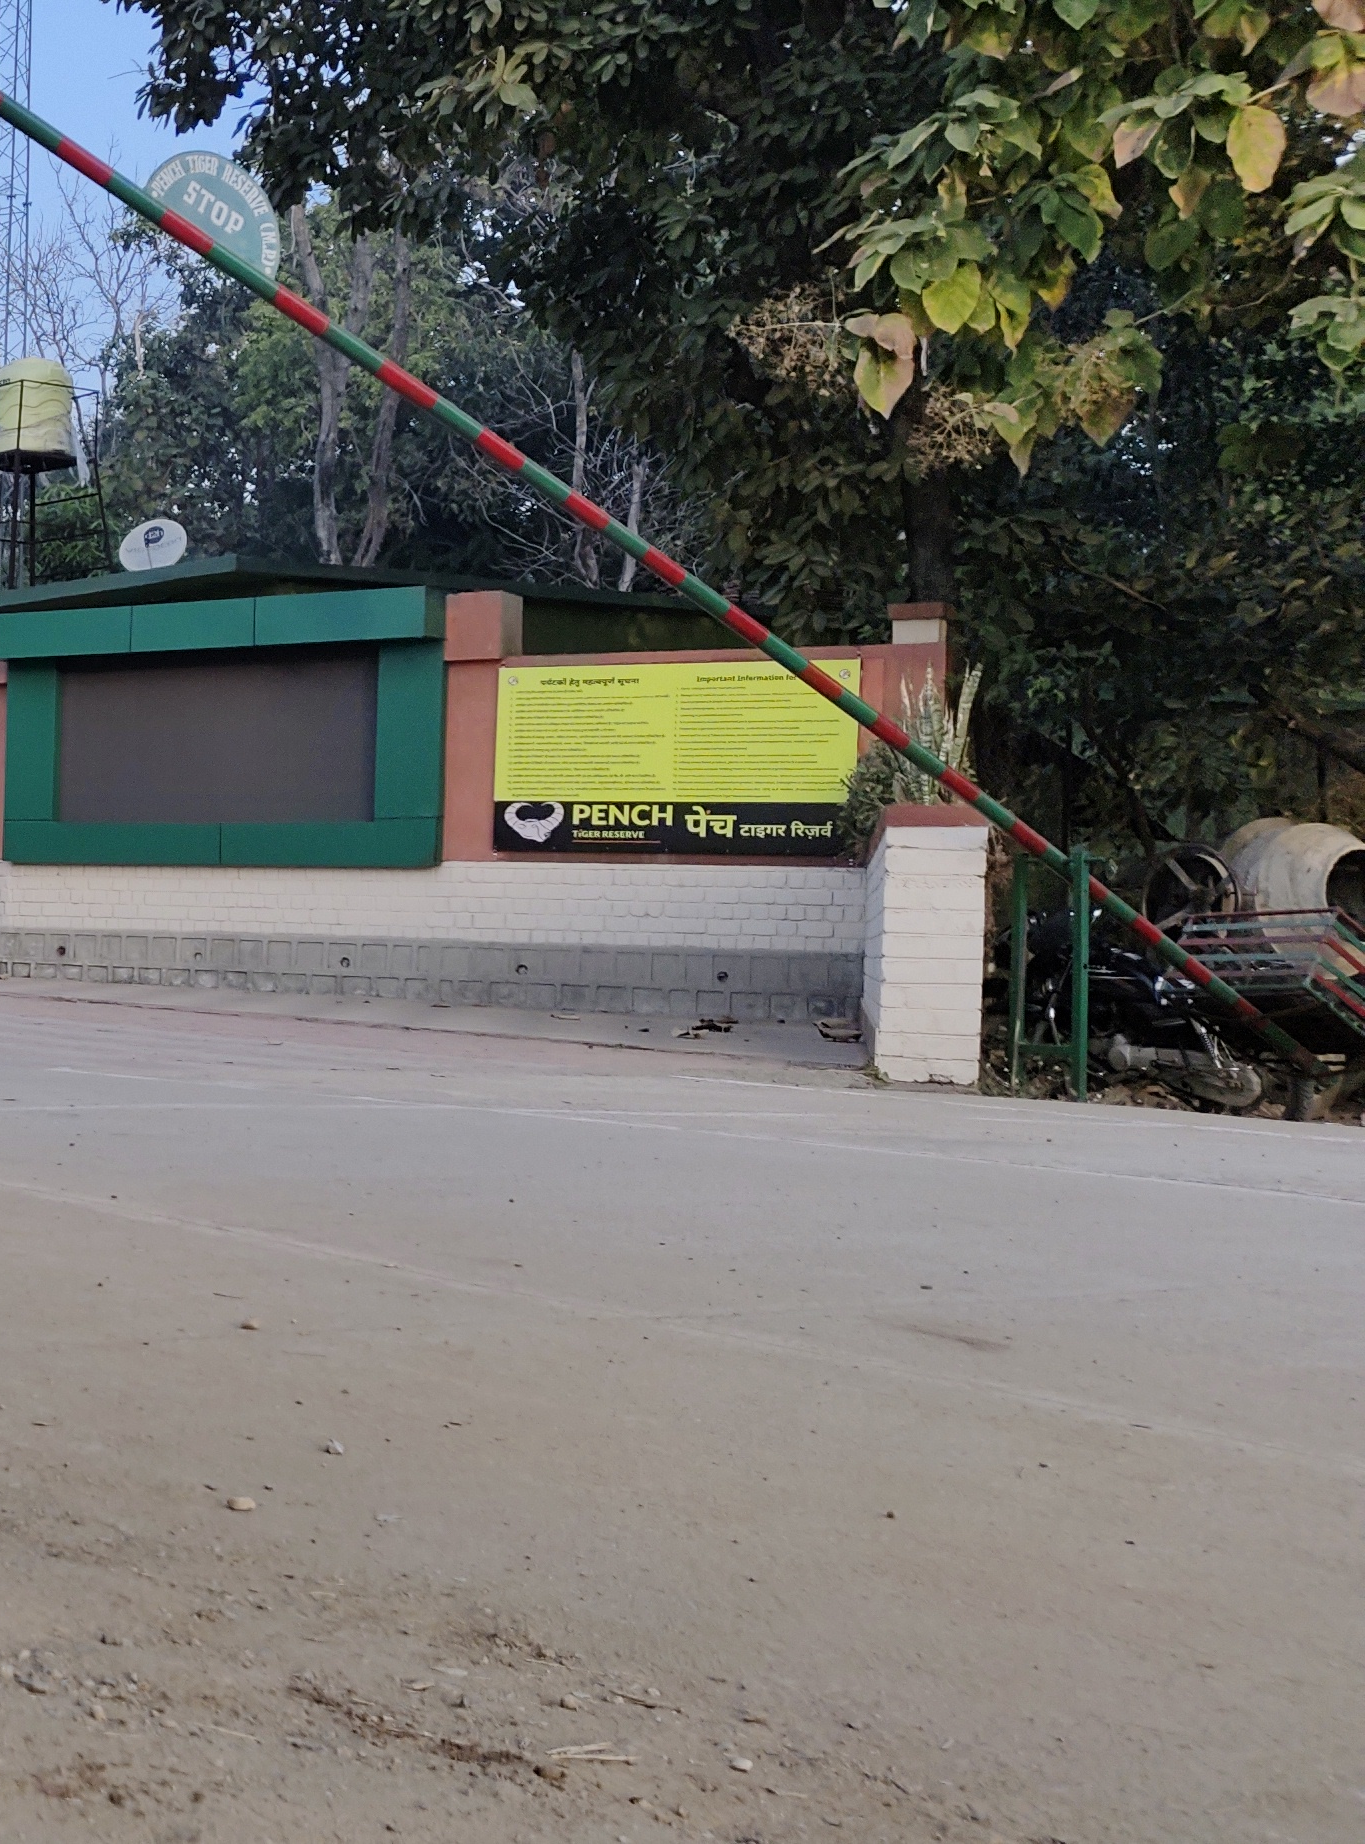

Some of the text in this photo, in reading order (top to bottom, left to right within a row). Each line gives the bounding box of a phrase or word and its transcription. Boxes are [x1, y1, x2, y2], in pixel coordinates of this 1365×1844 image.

[152, 161, 187, 198] PENCH
[185, 154, 219, 177] TIGER
[222, 163, 269, 218] RESERVE
[182, 180, 245, 235] STOP
[696, 675, 736, 684] Important
[737, 674, 784, 683] Information
[572, 804, 673, 827] PENCH
[684, 805, 834, 840] पेंच टाइगर रिज़र्व
[601, 830, 645, 839] RESERVE
